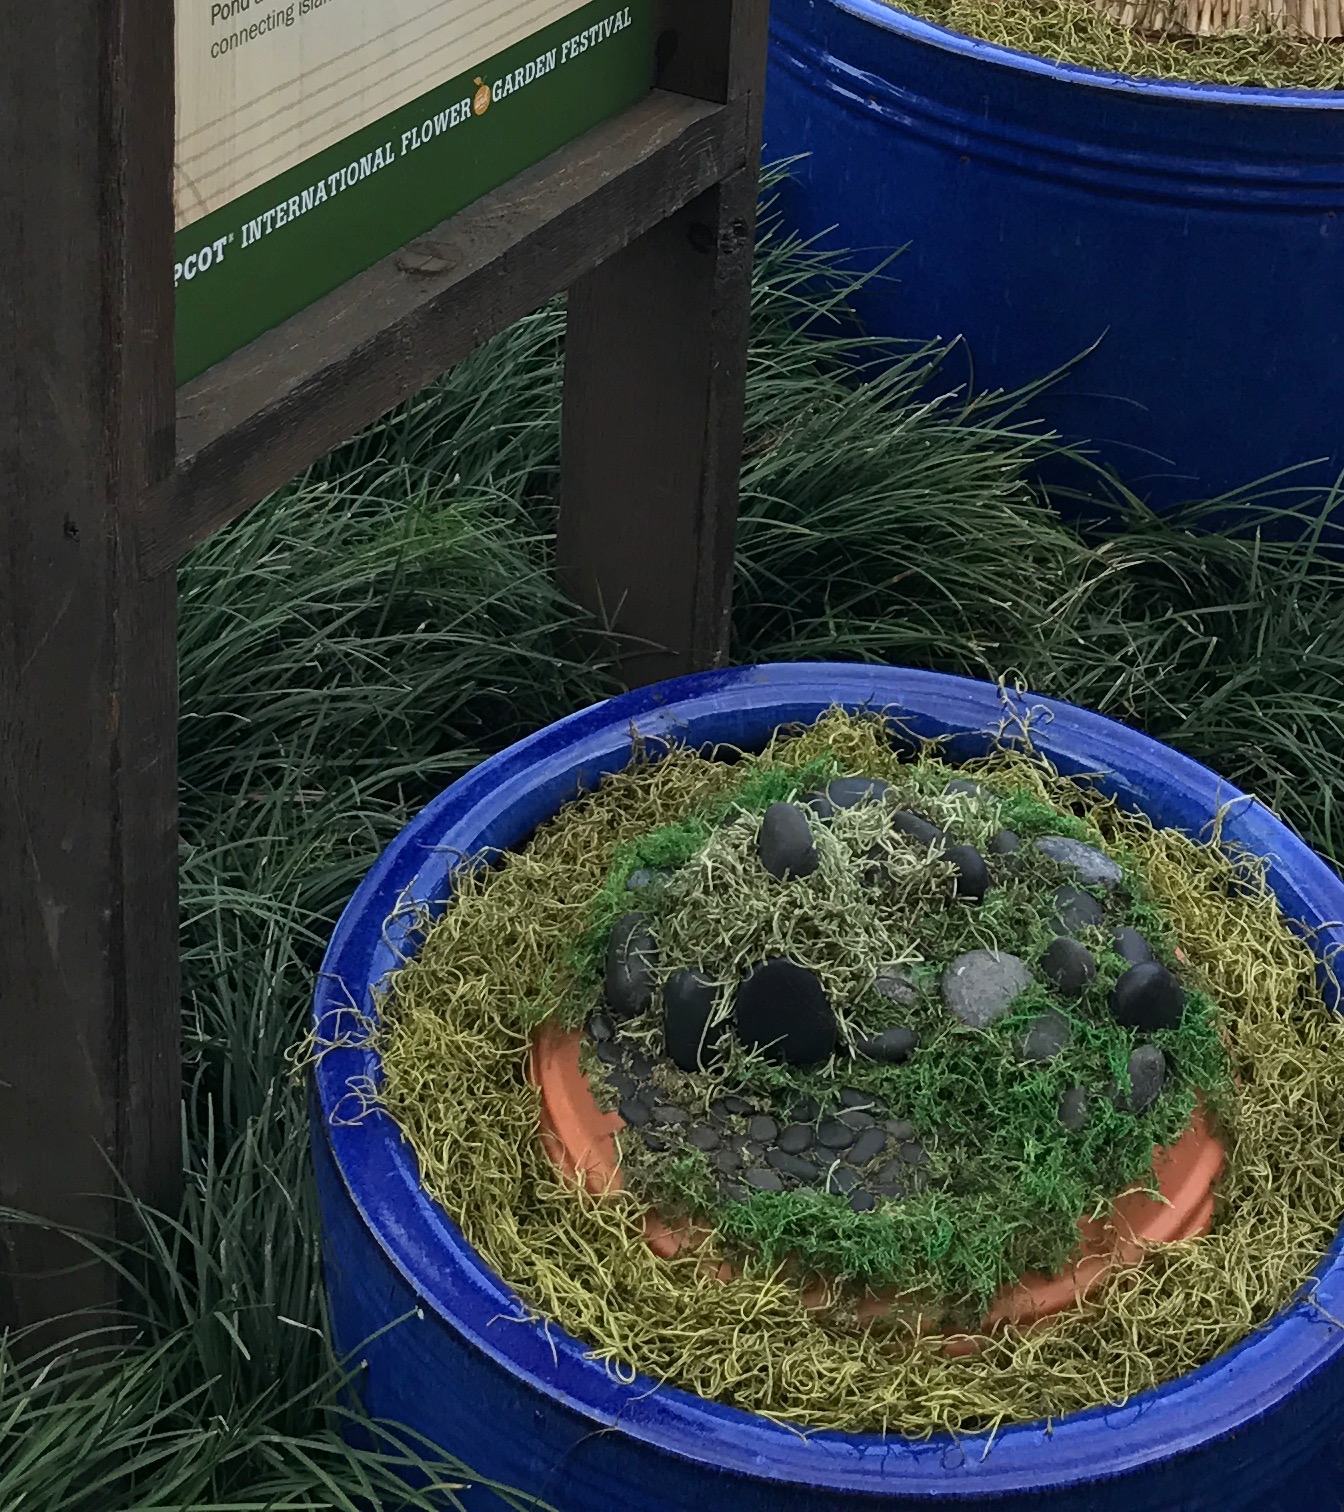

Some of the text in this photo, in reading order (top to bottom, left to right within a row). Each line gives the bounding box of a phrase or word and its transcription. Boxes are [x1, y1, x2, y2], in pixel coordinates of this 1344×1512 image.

[211, 2, 295, 58] connecting
[174, 6, 632, 288] PCOT INTERNATIONAL FLOWER GARDEN FESTIVAL
